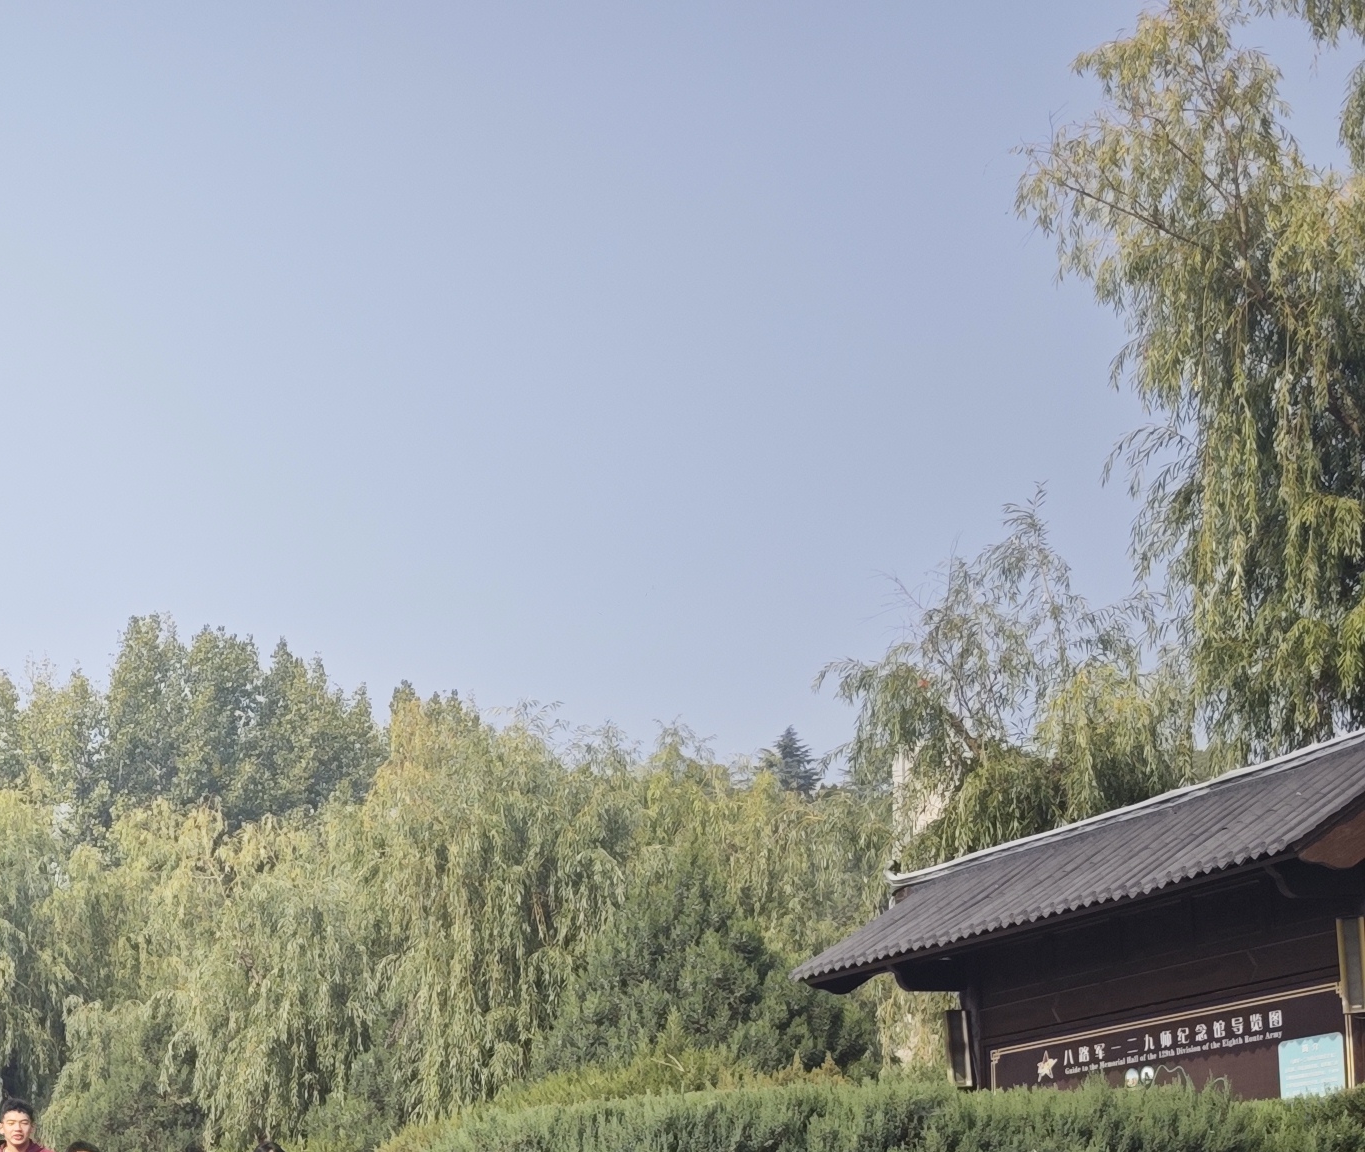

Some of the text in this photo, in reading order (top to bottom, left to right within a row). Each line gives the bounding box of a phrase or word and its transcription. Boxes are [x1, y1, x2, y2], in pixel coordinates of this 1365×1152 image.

[1064, 1010, 1282, 1066] 八路军一二九师纪念馆导览图
[1064, 1066, 1081, 1075] Guide
[1099, 1057, 1125, 1069] Memorial
[1127, 1055, 1139, 1064] Hall
[1147, 1052, 1157, 1060] the
[1159, 1049, 1175, 1059] 129th
[1176, 1045, 1201, 1055] Division
[1202, 1042, 1210, 1050] of
[1210, 1041, 1221, 1049] the
[1222, 1036, 1243, 1048] Eighth
[1244, 1034, 1264, 1043] Route
[1265, 1031, 1283, 1040] Army
